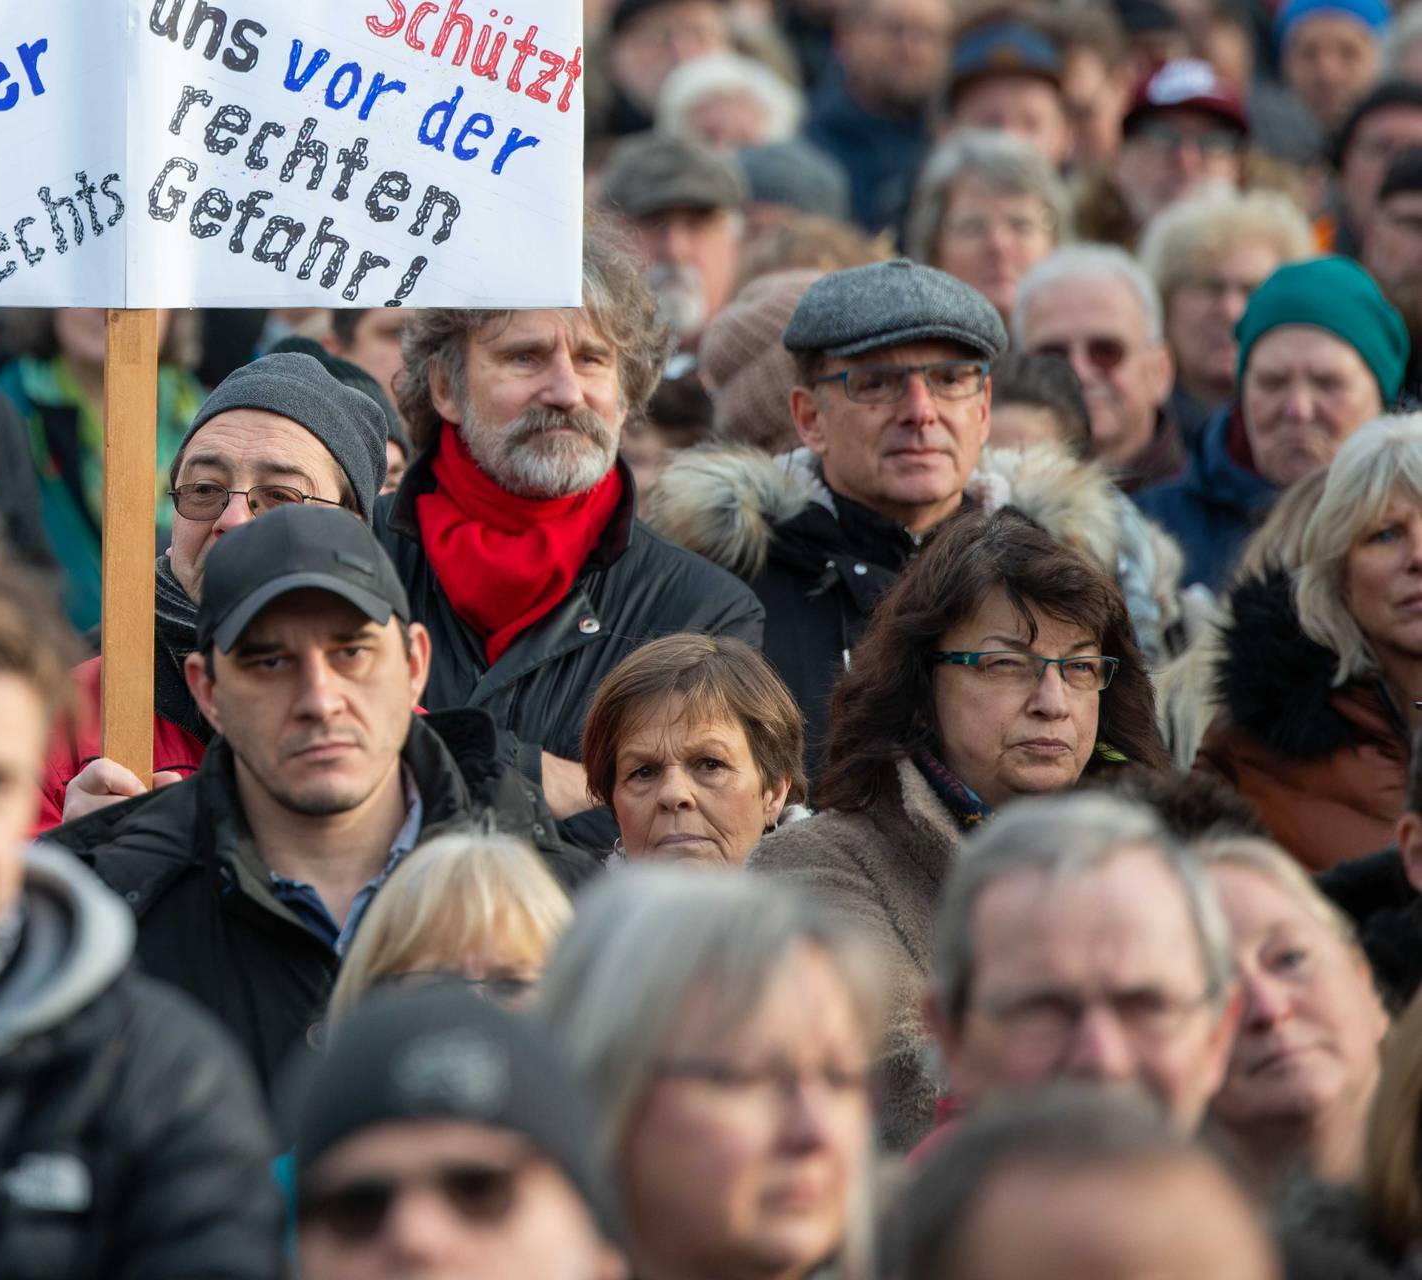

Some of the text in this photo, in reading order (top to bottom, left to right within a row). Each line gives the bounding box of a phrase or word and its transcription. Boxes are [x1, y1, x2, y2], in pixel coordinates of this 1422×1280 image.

[149, 0, 540, 174] uns vor der
[169, 86, 461, 244] rechten
[148, 157, 428, 307] Gefahr!
